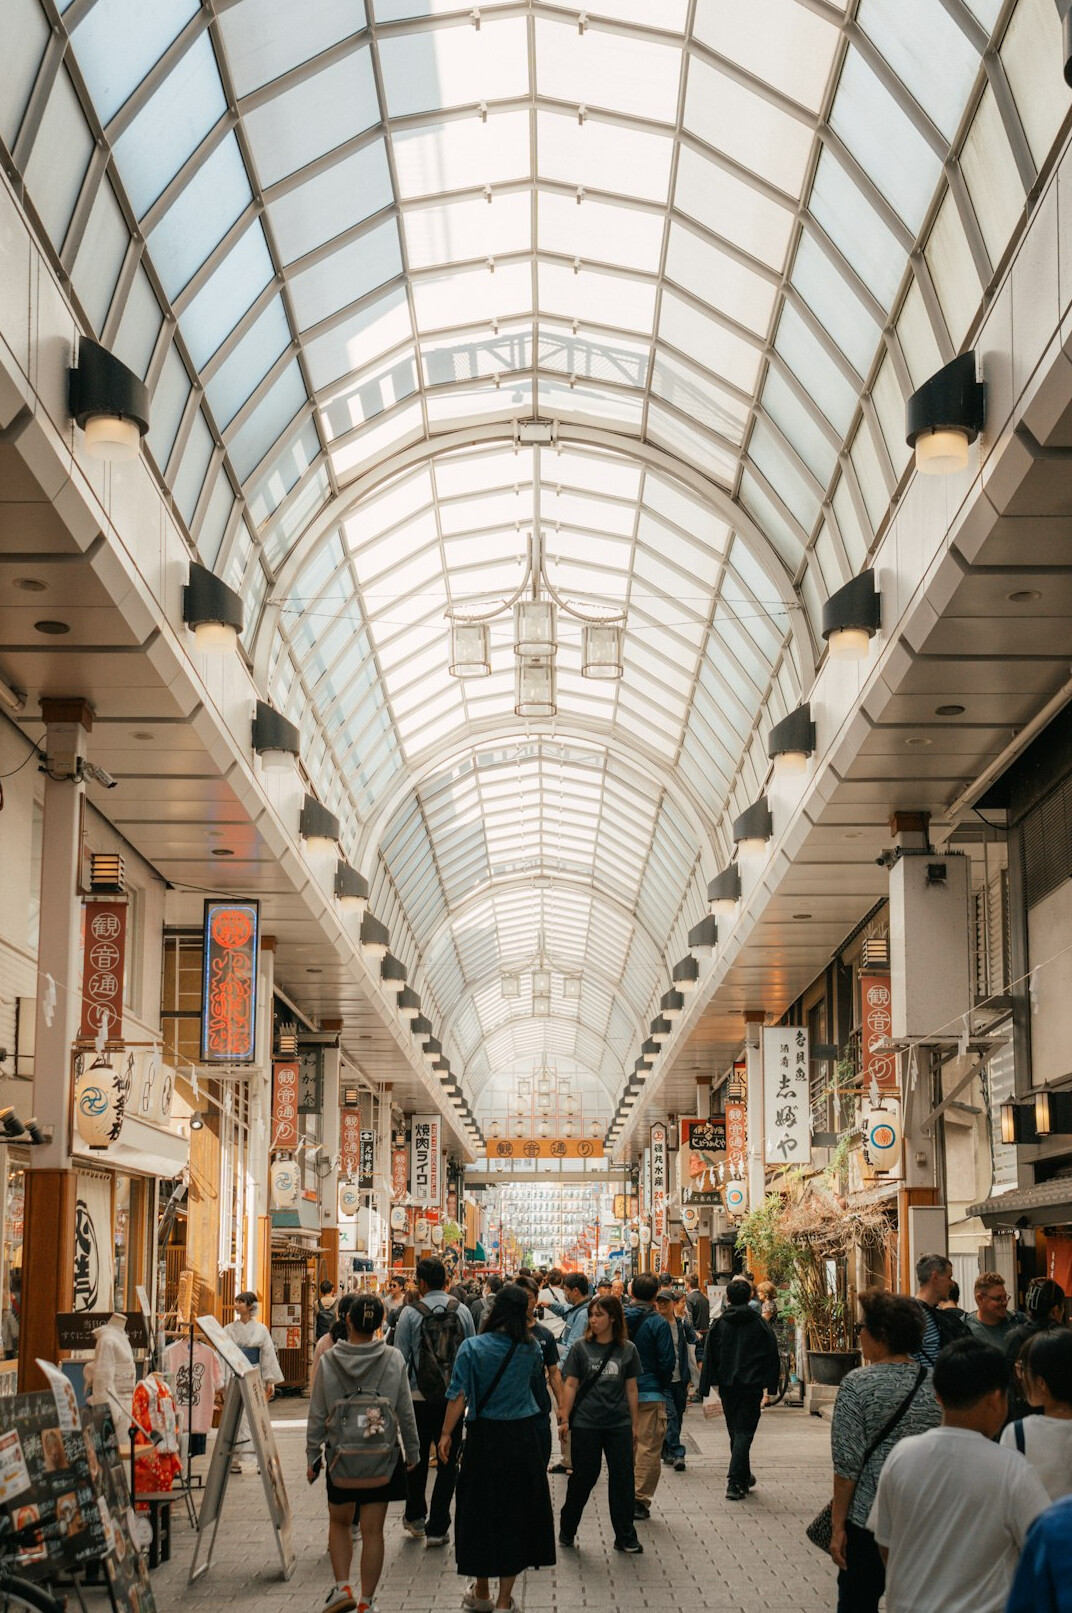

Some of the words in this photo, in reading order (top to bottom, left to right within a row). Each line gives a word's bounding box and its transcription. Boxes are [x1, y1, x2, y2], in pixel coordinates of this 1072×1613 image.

[87, 912, 121, 1031] 観音通り
[277, 1069, 295, 1139] 観音通り
[415, 1123, 430, 1185] 焼肉ライク
[496, 1140, 594, 1158] 観音通り
[654, 1143, 664, 1187] 磯丸水産
